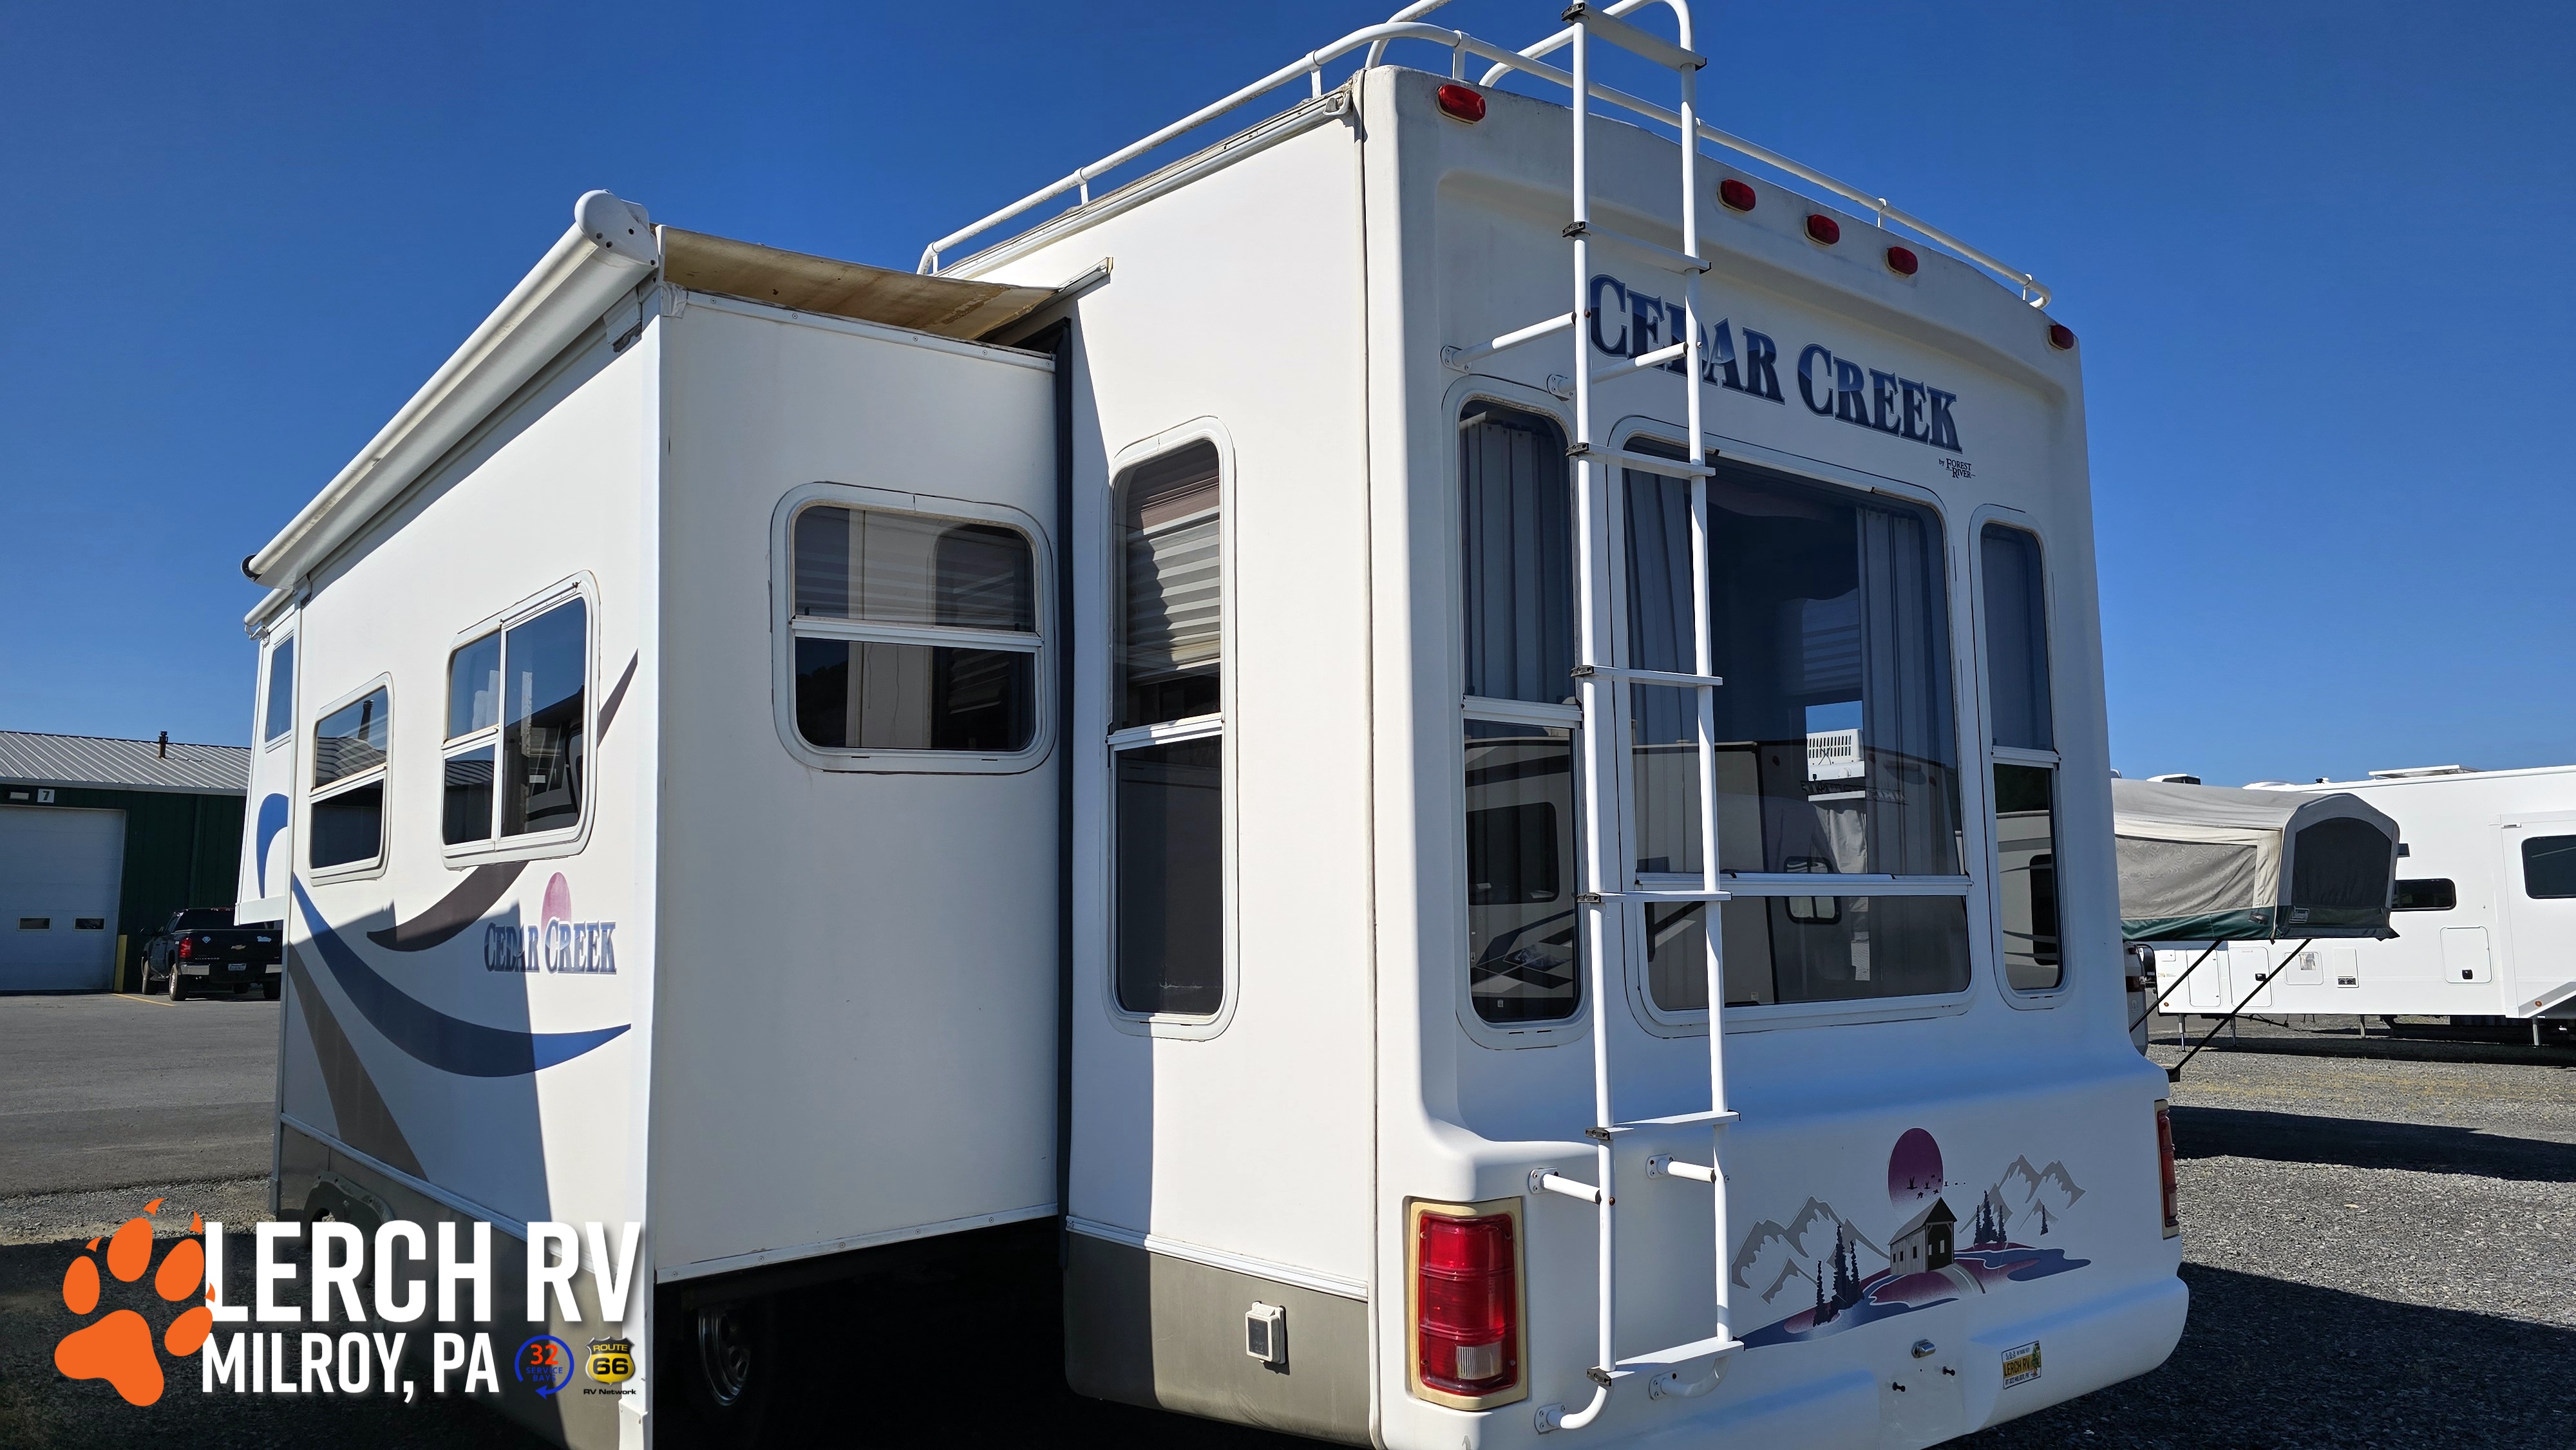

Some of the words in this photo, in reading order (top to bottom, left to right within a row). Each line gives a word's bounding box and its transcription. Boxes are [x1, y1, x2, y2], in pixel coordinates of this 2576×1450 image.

[1589, 273, 1786, 406] CEDAR
[1797, 342, 1963, 455] CREEK
[1938, 458, 1945, 467] by
[1946, 458, 1972, 471] FOREST
[1951, 467, 1972, 479] RIVER
[43, 790, 50, 801] 7
[484, 921, 540, 973] CEDAR
[544, 918, 617, 975] CREEK
[2004, 1359, 2022, 1377] LERCH
[2022, 1356, 2031, 1371] RV
